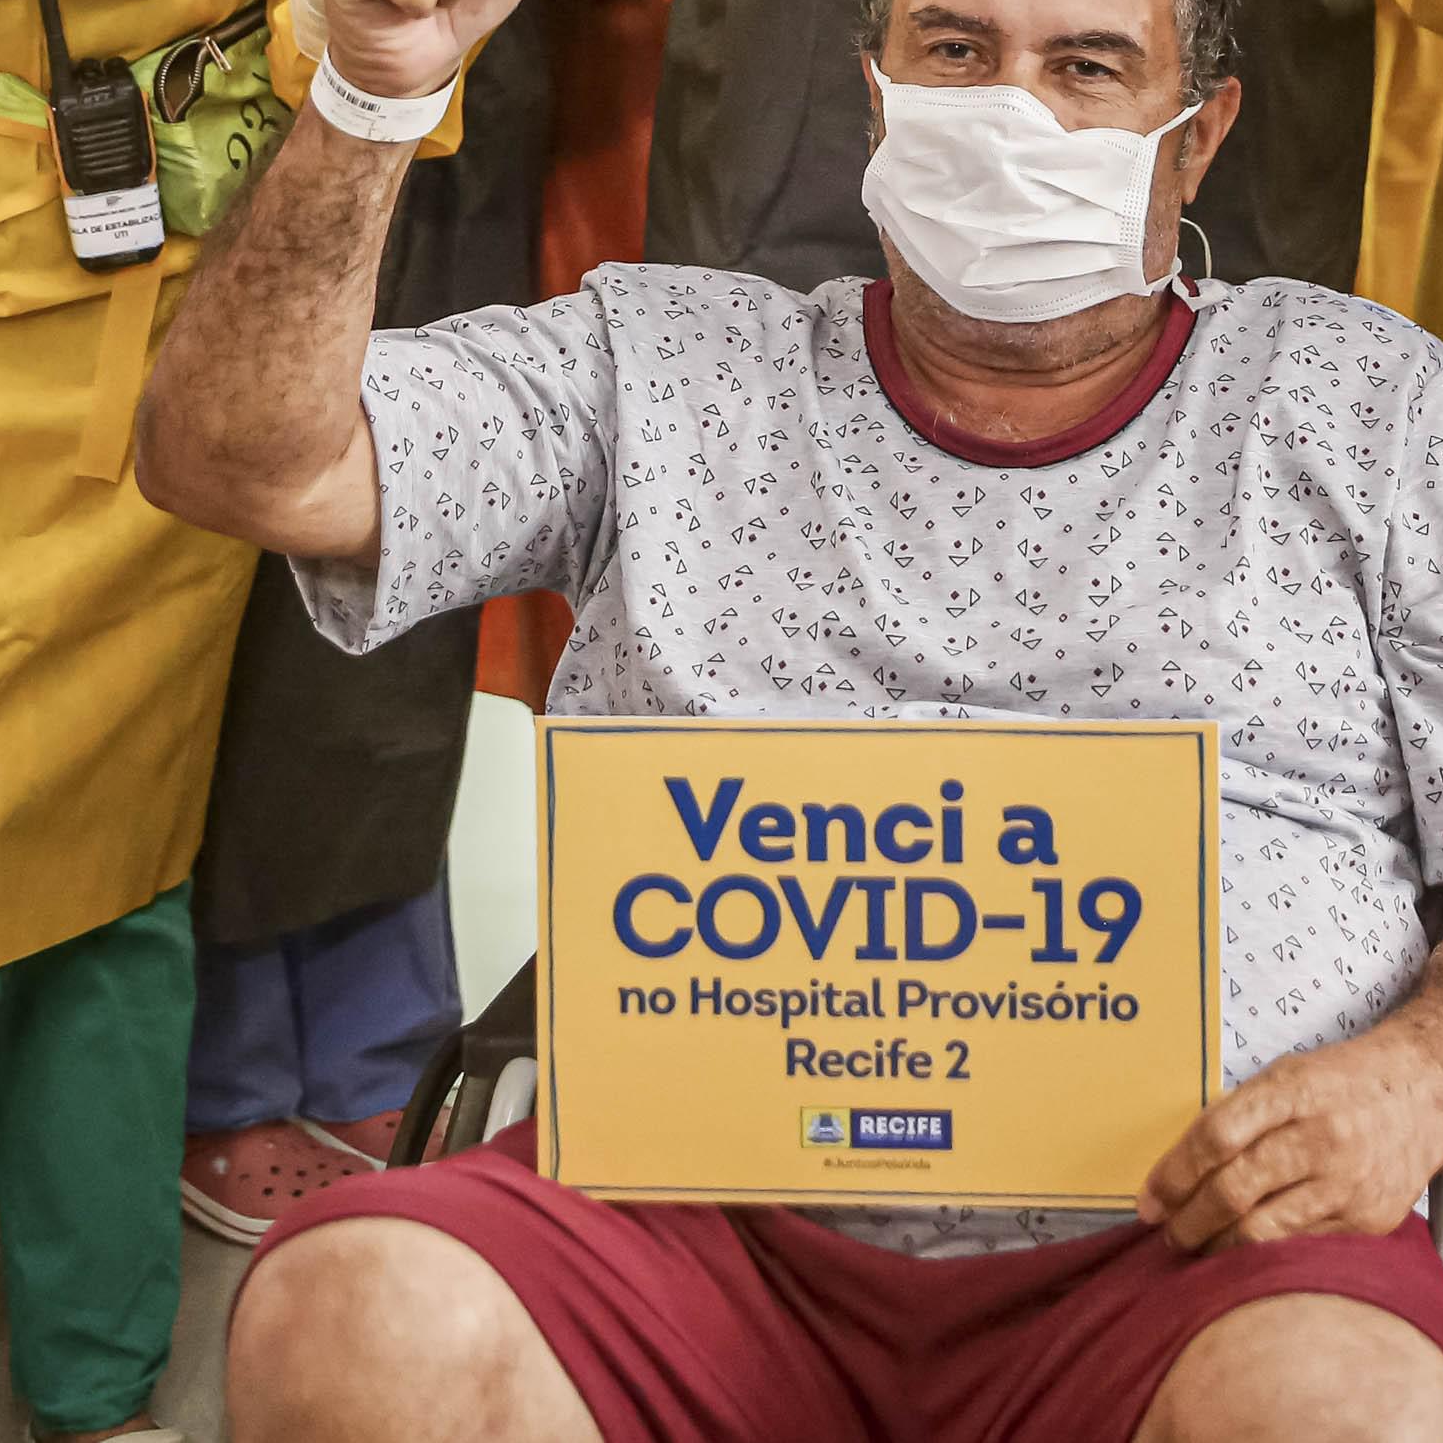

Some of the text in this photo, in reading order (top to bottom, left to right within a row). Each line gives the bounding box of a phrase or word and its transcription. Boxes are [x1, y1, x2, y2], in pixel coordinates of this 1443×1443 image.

[90, 225, 103, 234] DE
[663, 776, 1059, 865] Venci a
[612, 873, 1141, 963] COVID-19
[618, 976, 1139, 1029] no Hospital Provisório
[786, 1037, 971, 1079] Recife 2
[859, 1116, 942, 1136] RECIFE
